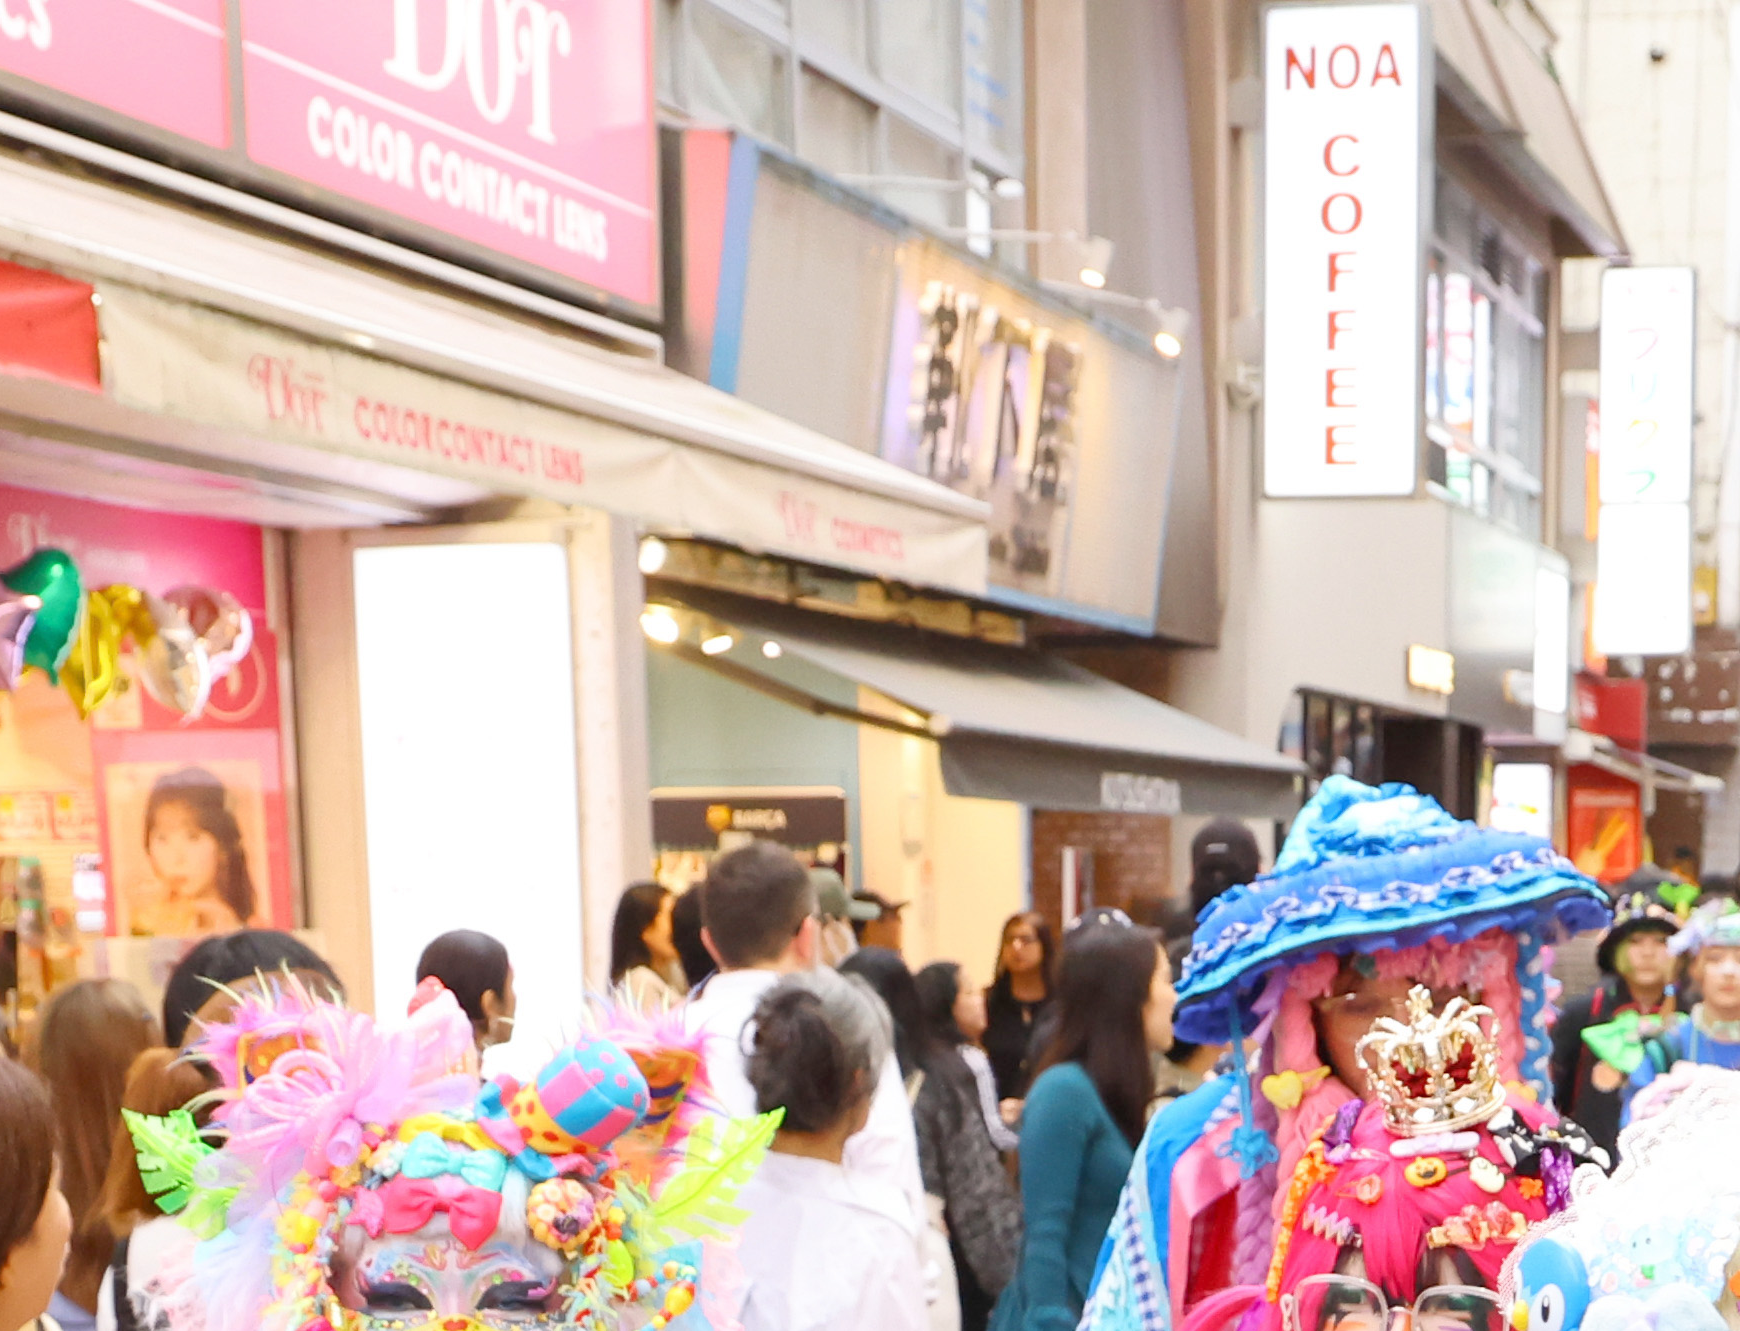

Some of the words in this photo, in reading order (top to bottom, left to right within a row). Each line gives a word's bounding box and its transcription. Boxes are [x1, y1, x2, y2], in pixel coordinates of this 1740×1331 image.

[1284, 44, 1404, 90] NOA
[307, 96, 416, 191] COLOR
[419, 140, 549, 239] CONTACT
[552, 179, 609, 263] LENS
[1320, 134, 1364, 466] COFFEE
[354, 396, 435, 453] COLOR
[436, 418, 535, 474] CONTACT
